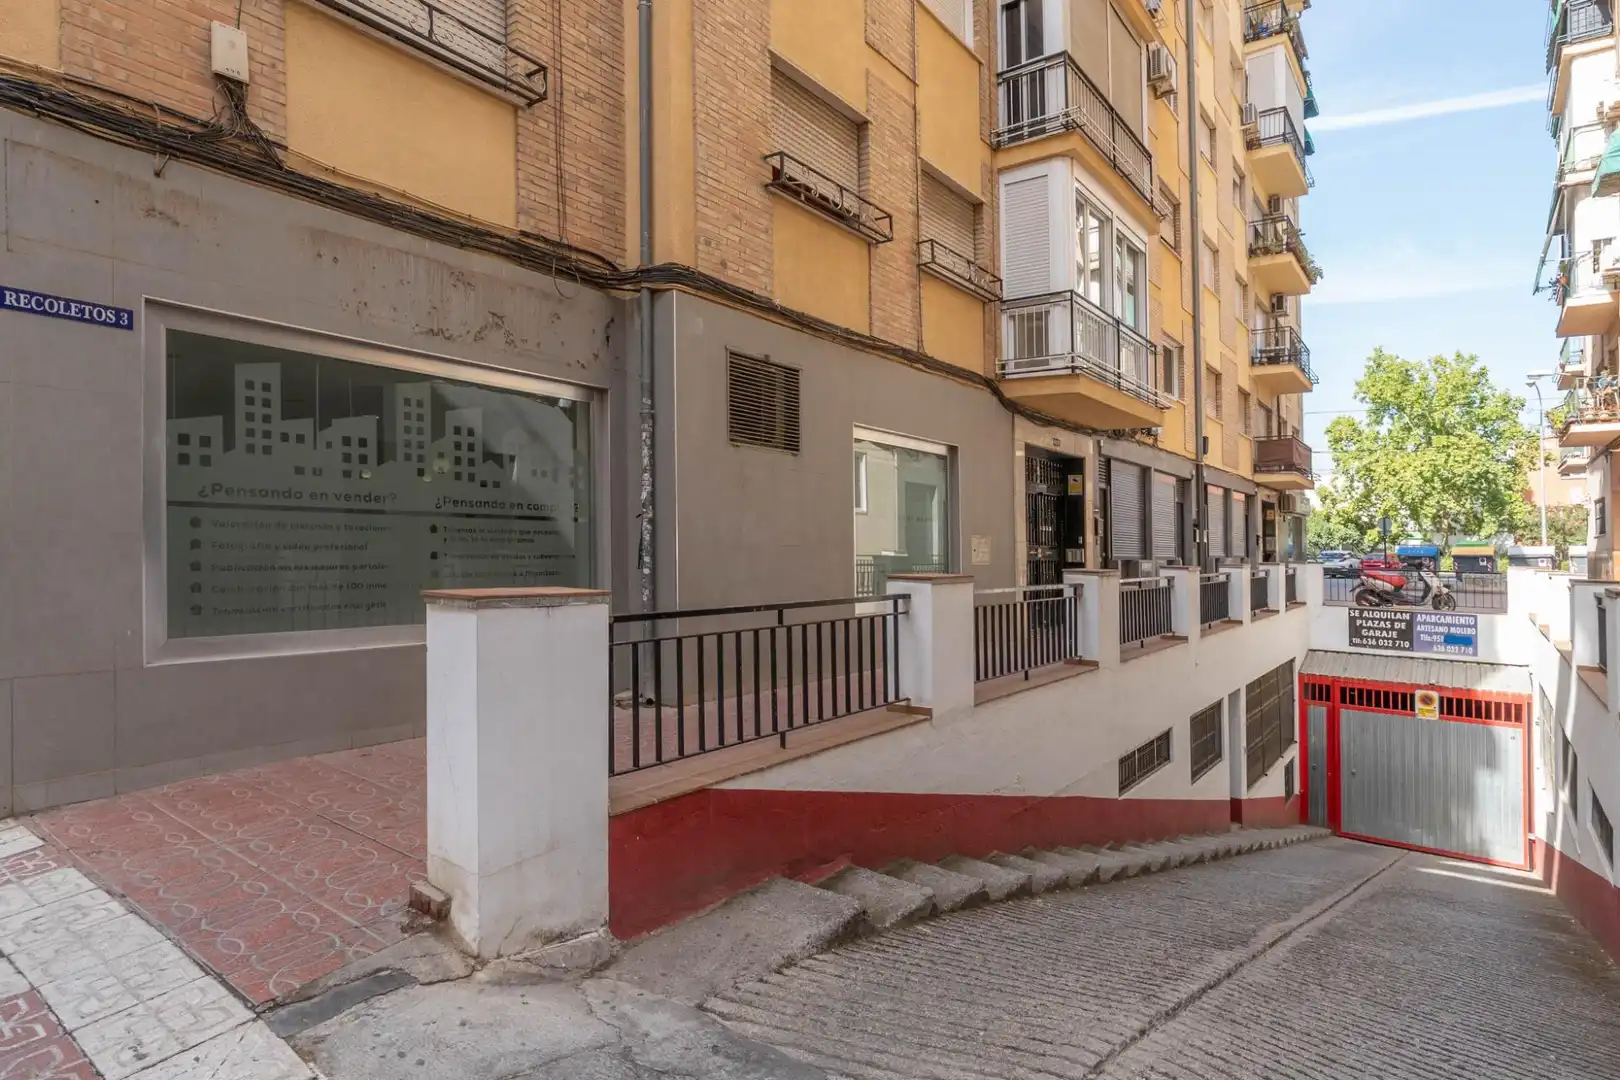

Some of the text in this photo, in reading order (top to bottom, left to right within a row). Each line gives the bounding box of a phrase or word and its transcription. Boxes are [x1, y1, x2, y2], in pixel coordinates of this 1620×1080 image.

[4, 290, 129, 325] RECOLETOS 3
[198, 482, 304, 501] ¿Pensando
[309, 491, 329, 501] en
[434, 495, 506, 511] ¿Pensando
[510, 501, 524, 511] en
[1349, 609, 1410, 620] SE ALQUILAN
[1416, 614, 1475, 625] APARCAMIENTO
[1356, 619, 1391, 628] PLAZAS
[1361, 629, 1398, 638] GARAJE
[1416, 624, 1476, 635] ARTESANO MOLERO
[1395, 640, 1410, 648] 710
